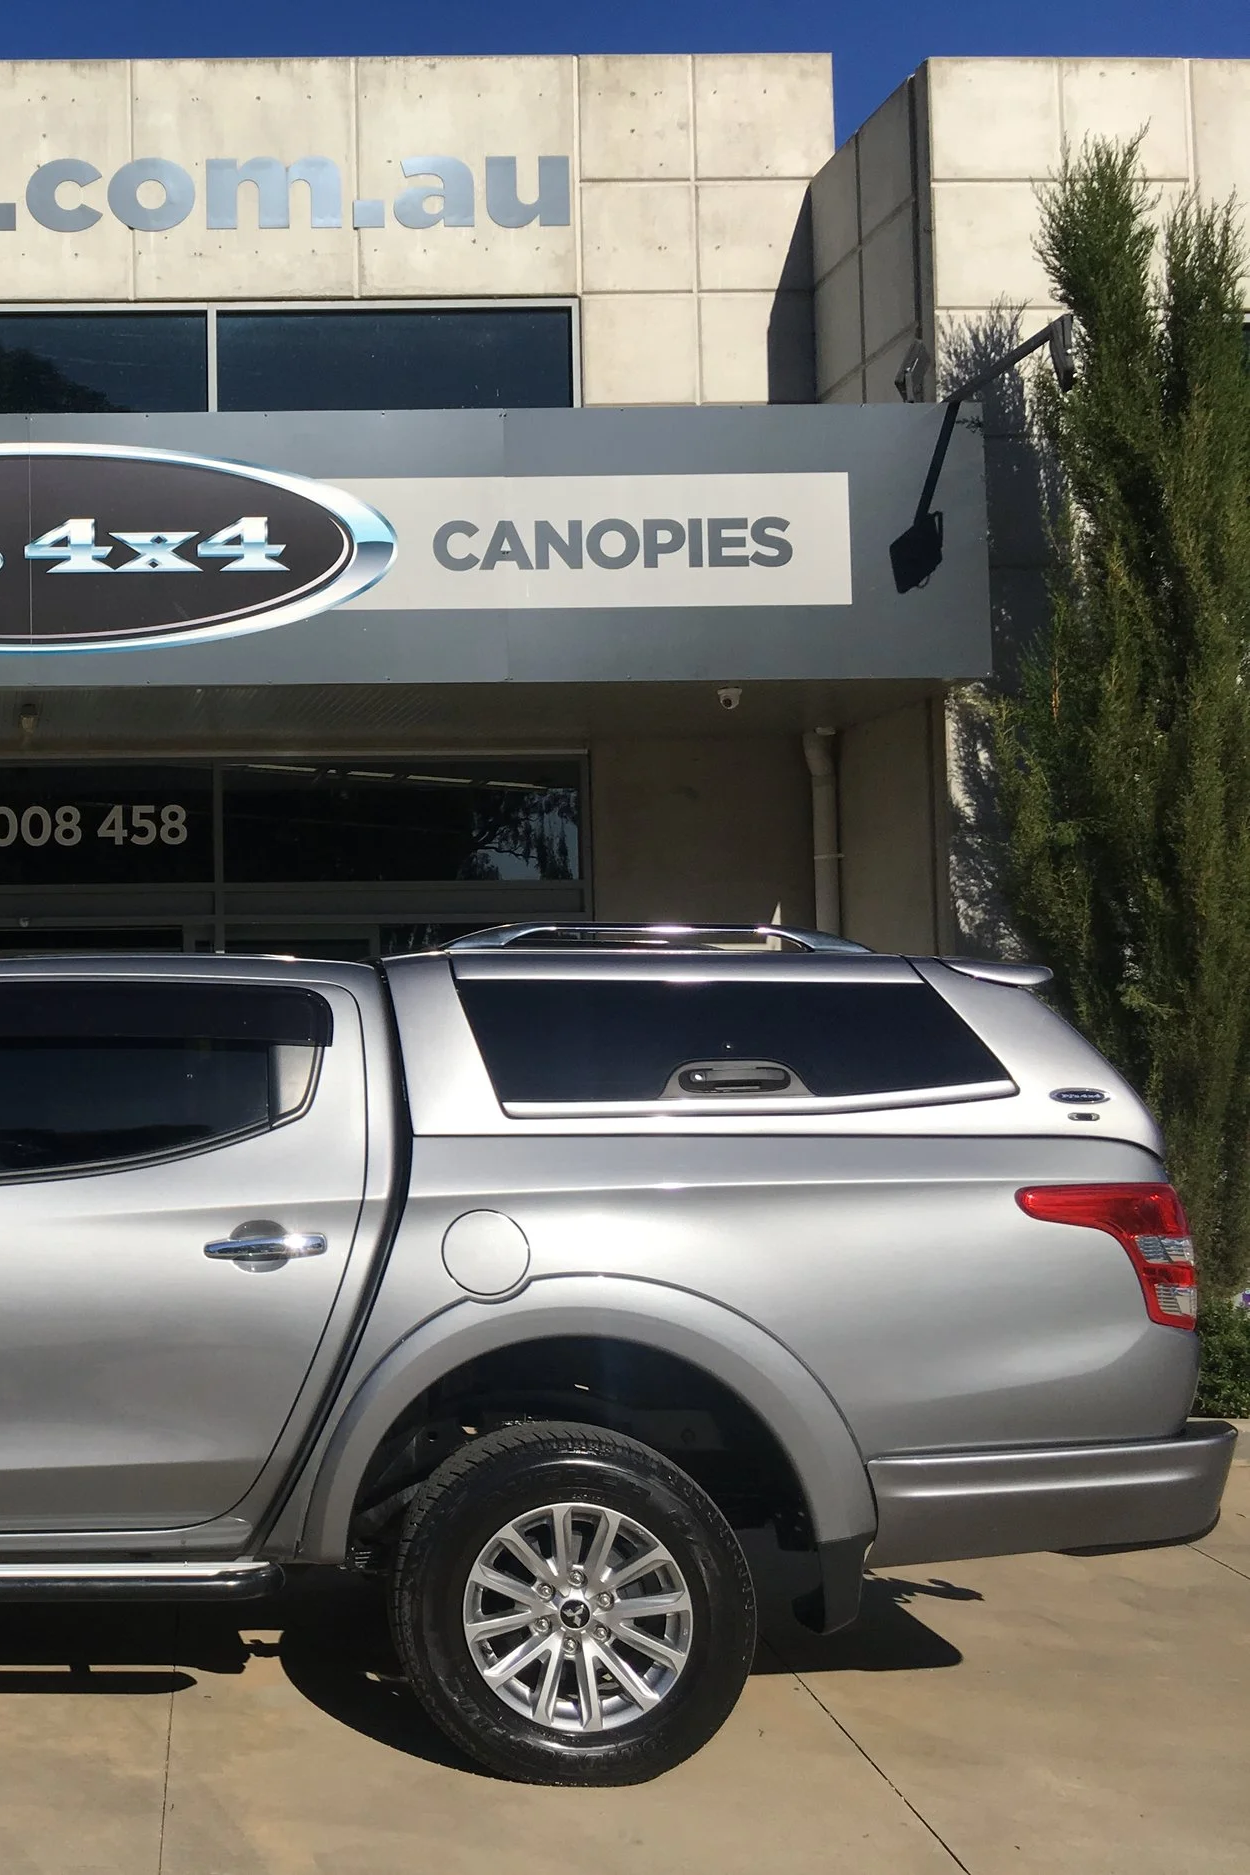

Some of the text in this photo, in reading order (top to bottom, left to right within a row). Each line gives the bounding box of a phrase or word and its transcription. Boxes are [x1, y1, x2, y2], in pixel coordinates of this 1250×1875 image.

[23, 516, 291, 574] 4x4
[432, 516, 794, 572] CANOPIES
[96, 804, 188, 846] 458
